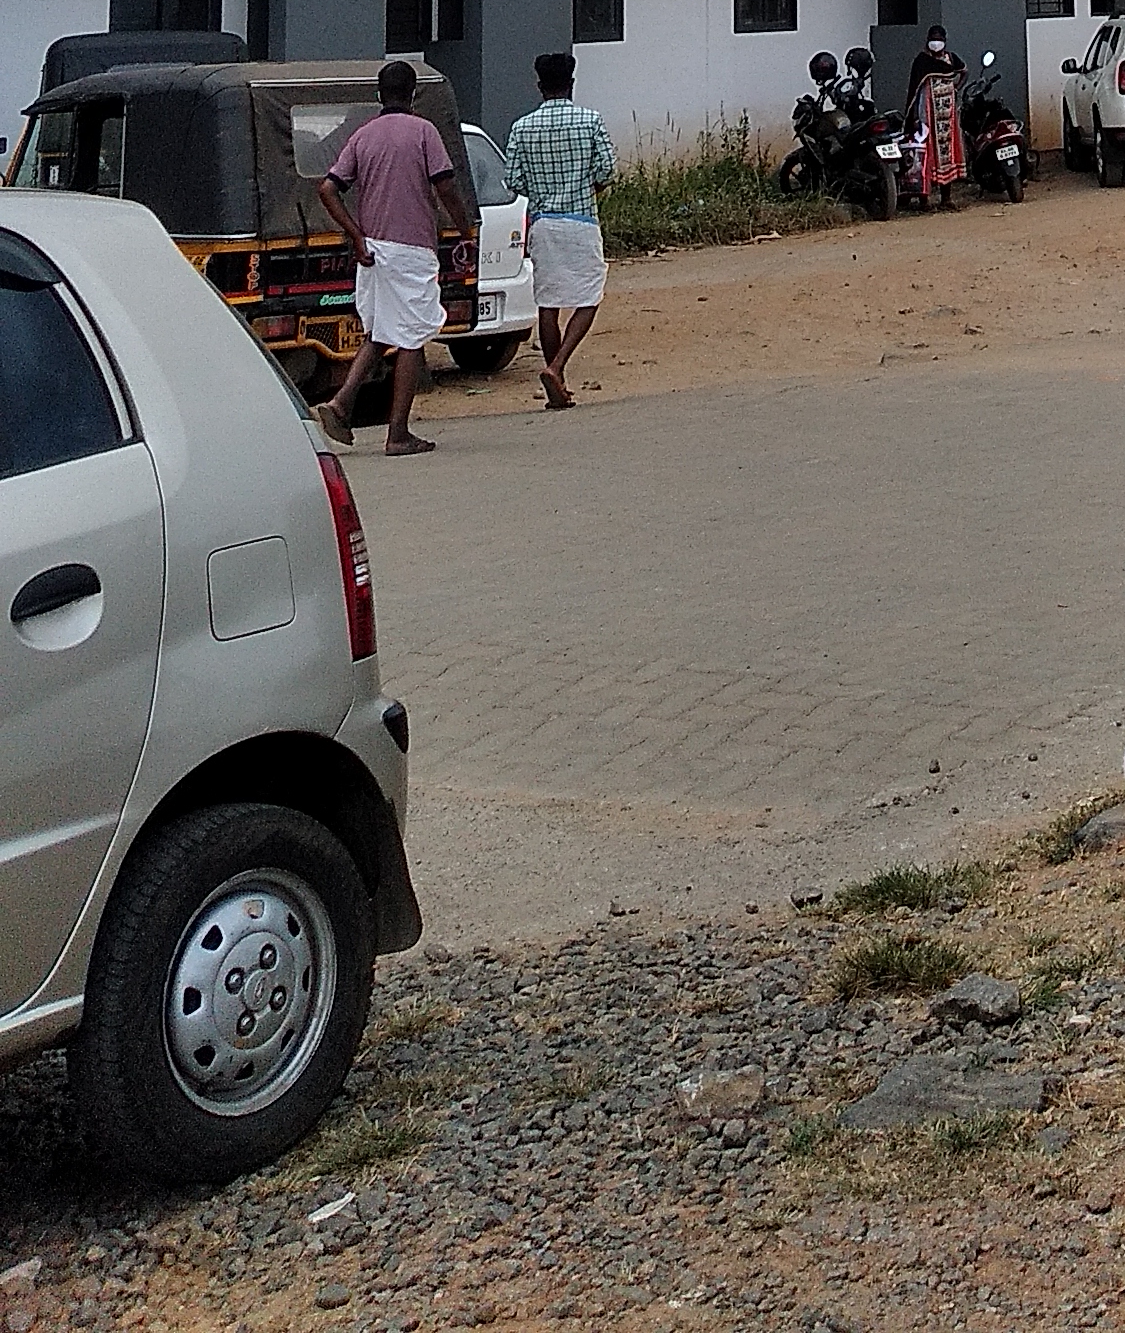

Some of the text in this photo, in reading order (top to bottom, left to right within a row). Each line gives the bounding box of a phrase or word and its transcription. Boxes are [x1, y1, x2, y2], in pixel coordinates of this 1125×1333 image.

[247, 253, 260, 291] STOP
[479, 301, 491, 316] 85
[341, 334, 367, 349] H.57
